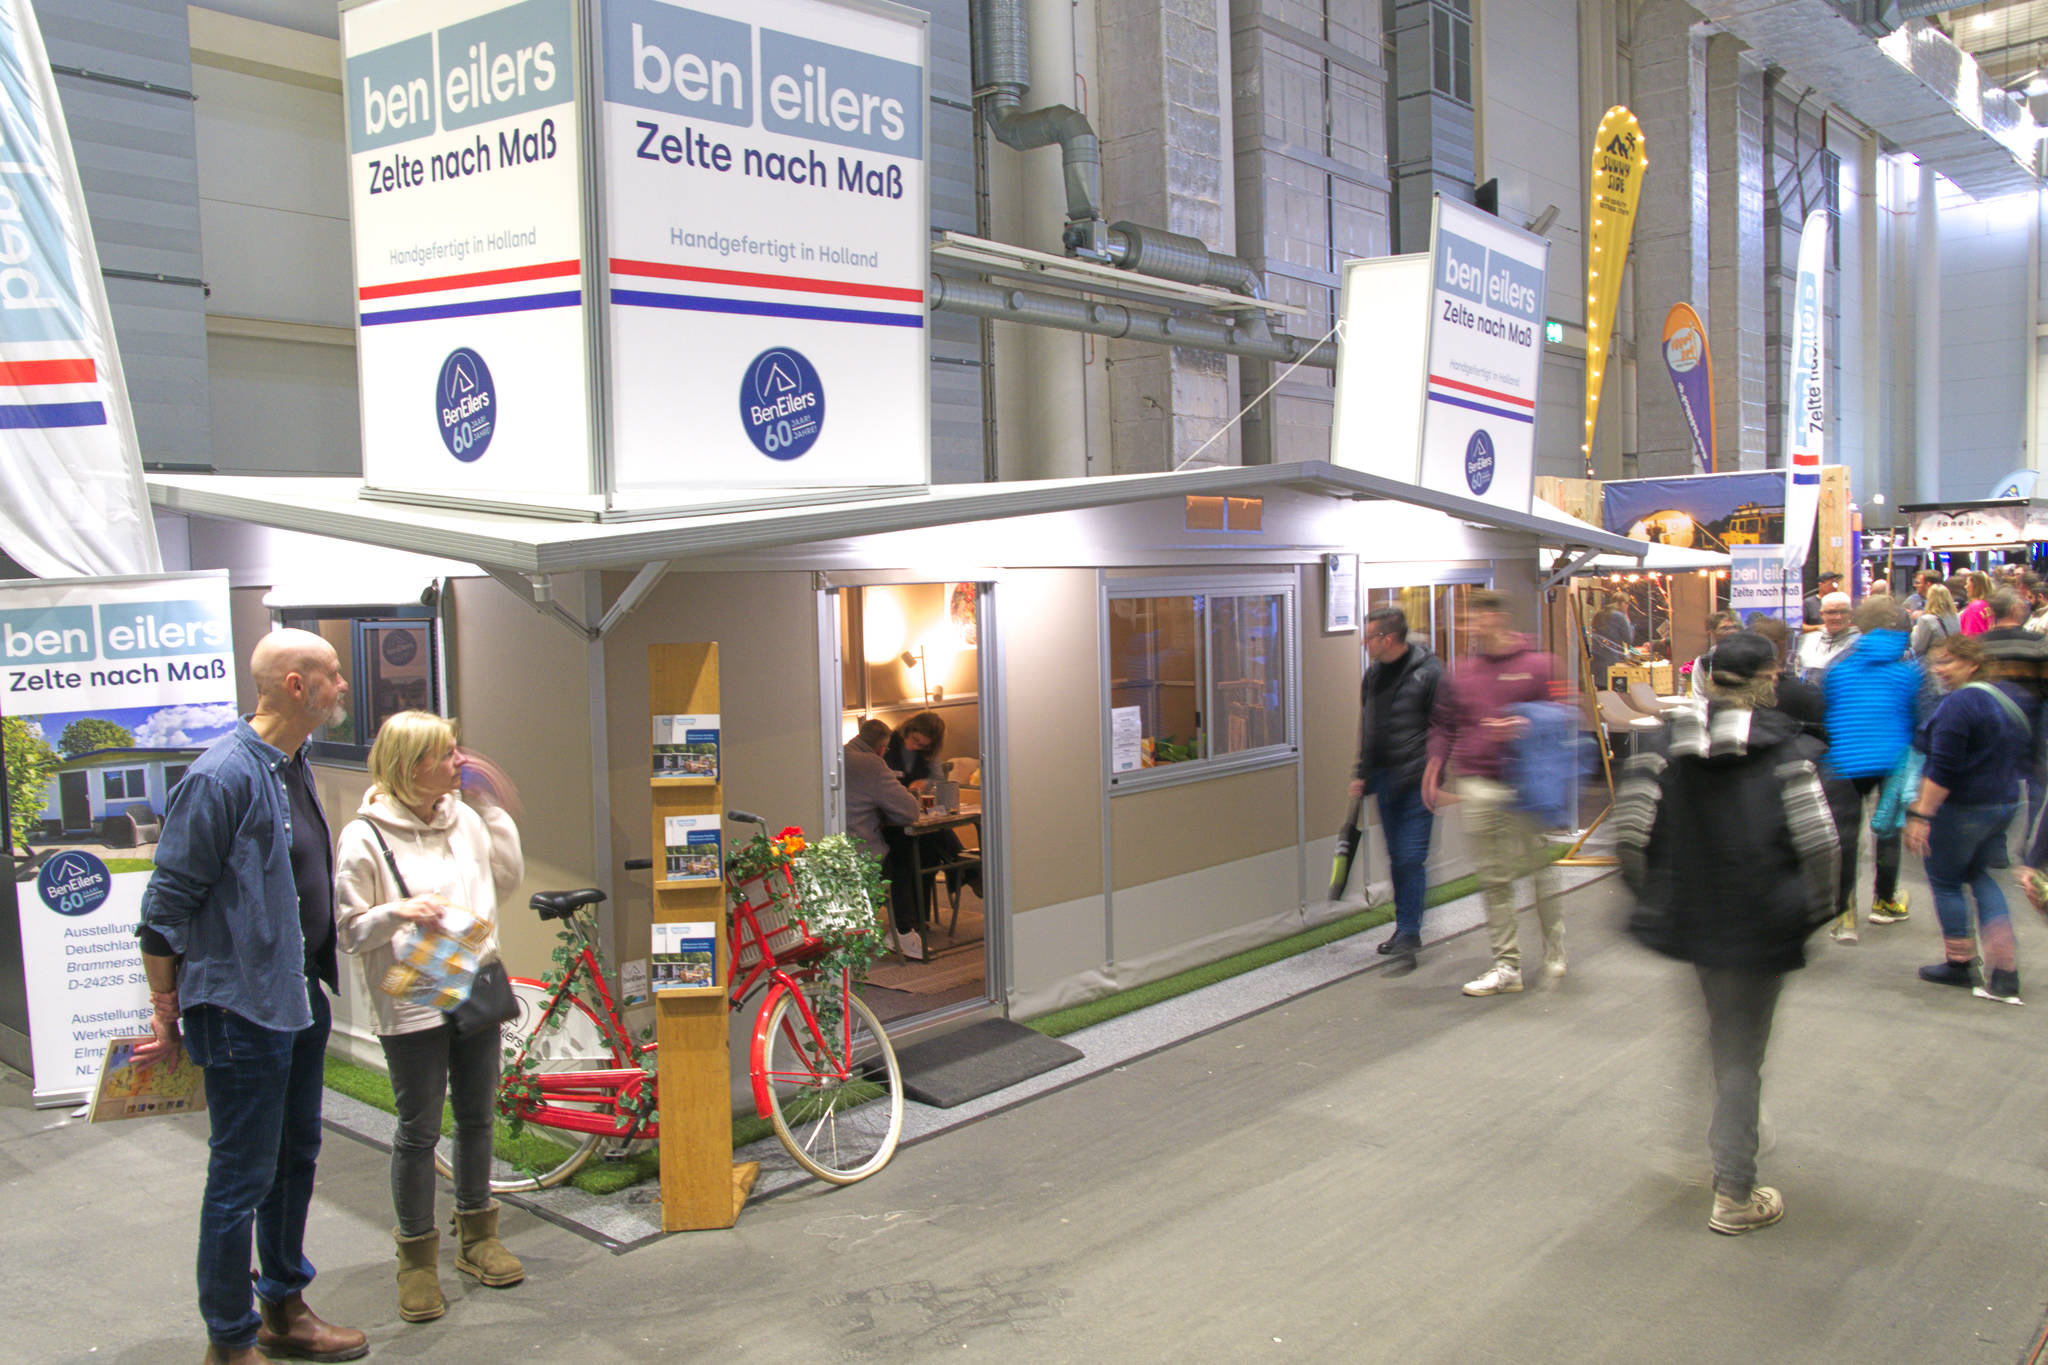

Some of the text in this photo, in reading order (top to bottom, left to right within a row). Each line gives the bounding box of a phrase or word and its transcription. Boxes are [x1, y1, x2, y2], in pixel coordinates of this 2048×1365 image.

[363, 41, 556, 135] ben eilers
[632, 22, 905, 142] ben eilers
[369, 118, 557, 194] Zelte nach Maß
[636, 120, 903, 200] Zelte nach Maß
[390, 225, 536, 267] Handgefertigt in Holland
[670, 226, 878, 268] Handgefertigt in Holland
[1445, 246, 1536, 313] ben eilers
[1443, 299, 1533, 348] Zelte nach Maß
[442, 391, 490, 428] BenEilers
[750, 392, 816, 426] BenEilers
[453, 420, 473, 454] 60
[764, 420, 793, 452] 60
[4, 615, 226, 657] ben eilers
[9, 658, 226, 692] Zelte nach Maß
[47, 873, 103, 898] BenEilers
[60, 892, 84, 912] 60
[65, 940, 141, 955] Deutschlan
[68, 974, 125, 990] D-24235
[72, 1026, 135, 1041] Werkstatt
